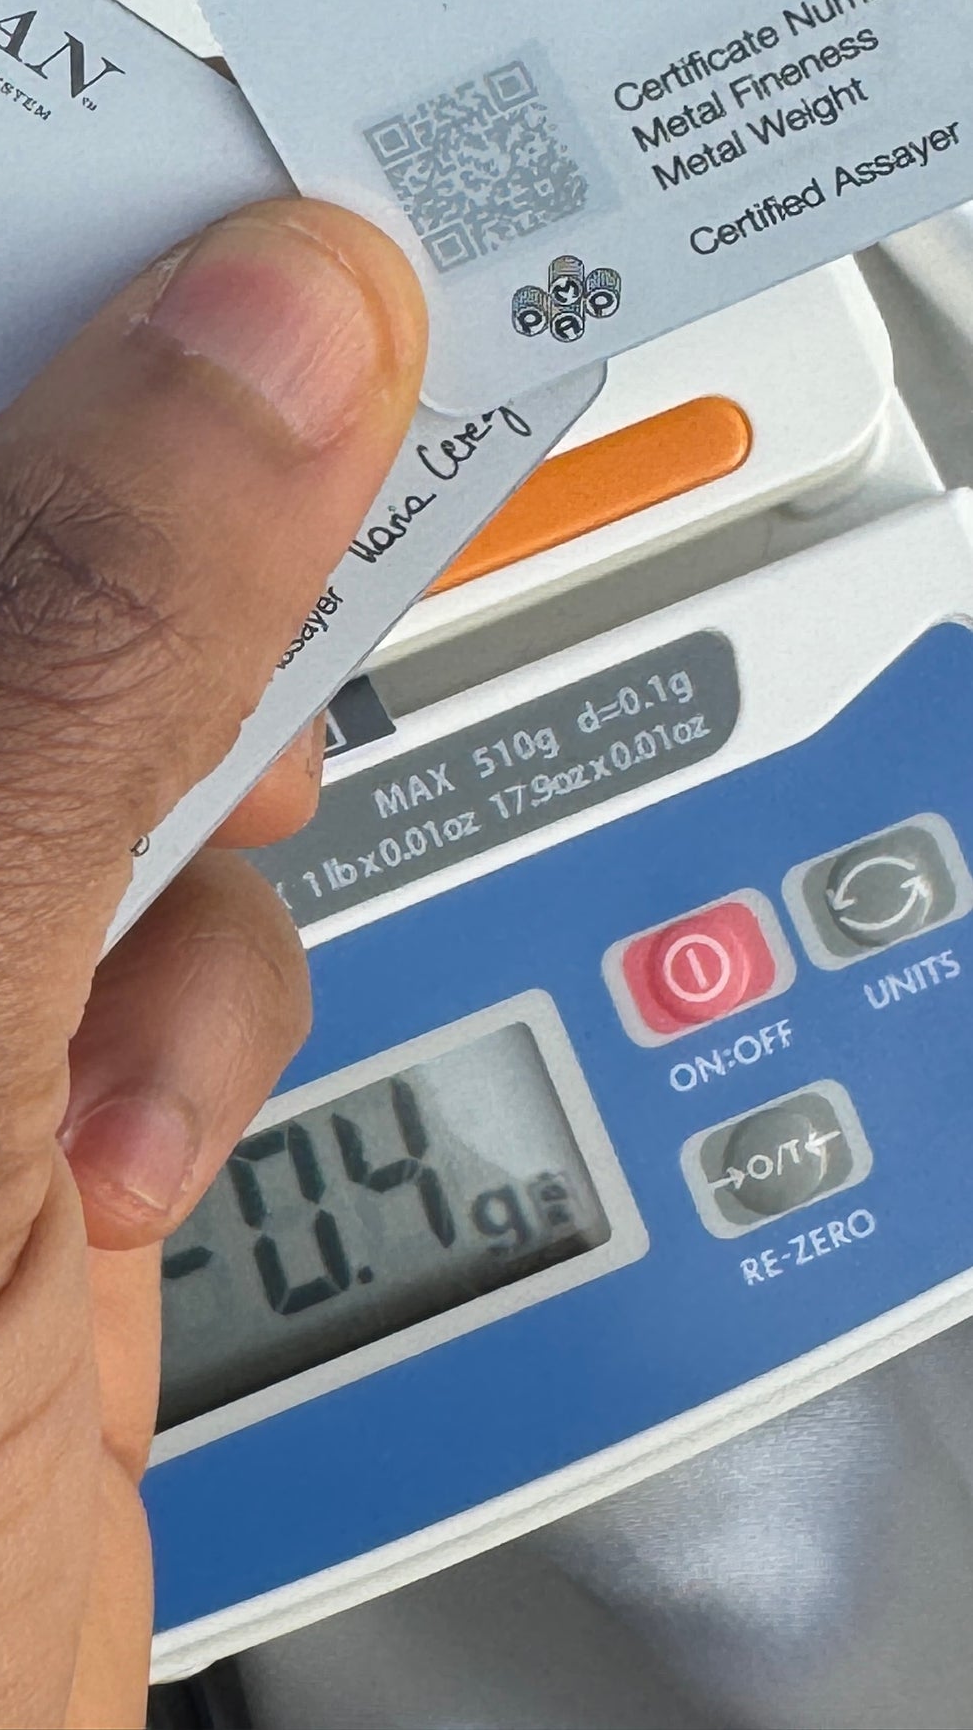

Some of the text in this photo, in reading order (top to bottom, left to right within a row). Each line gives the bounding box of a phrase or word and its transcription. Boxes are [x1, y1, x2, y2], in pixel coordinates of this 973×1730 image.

[613, 24, 779, 113] Certificate
[631, 27, 880, 153] Metal Fineness
[651, 77, 870, 191] Metal Weight
[689, 121, 961, 256] Certified Assayer
[276, 586, 343, 670] ssayer
[374, 670, 695, 819] MAX 510g d=0.1g
[863, 949, 961, 1010] UNITS
[740, 1208, 876, 1286] RE-ZERO
